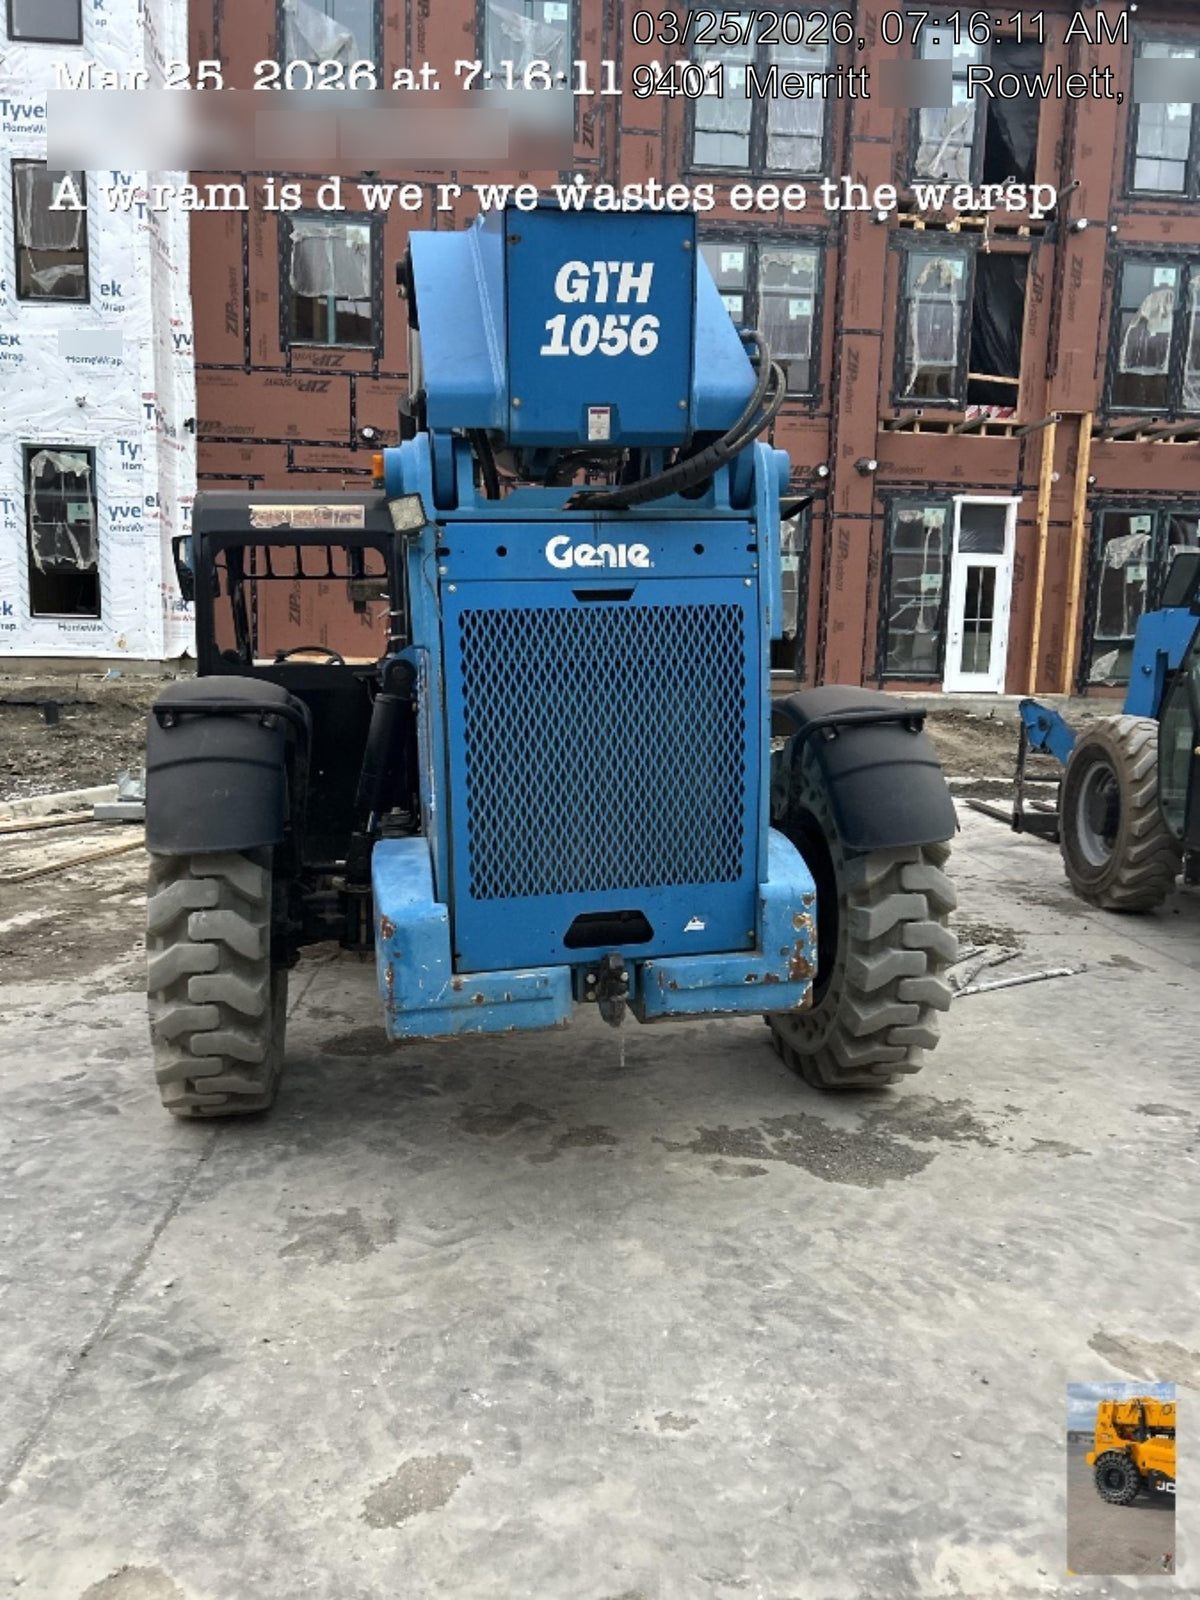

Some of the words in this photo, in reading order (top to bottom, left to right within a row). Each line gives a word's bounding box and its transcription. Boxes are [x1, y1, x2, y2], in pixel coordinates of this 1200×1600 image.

[0, 99, 47, 121] Tyve
[554, 260, 656, 304] GTH
[539, 313, 661, 357] 1056
[545, 534, 650, 569] Genie
